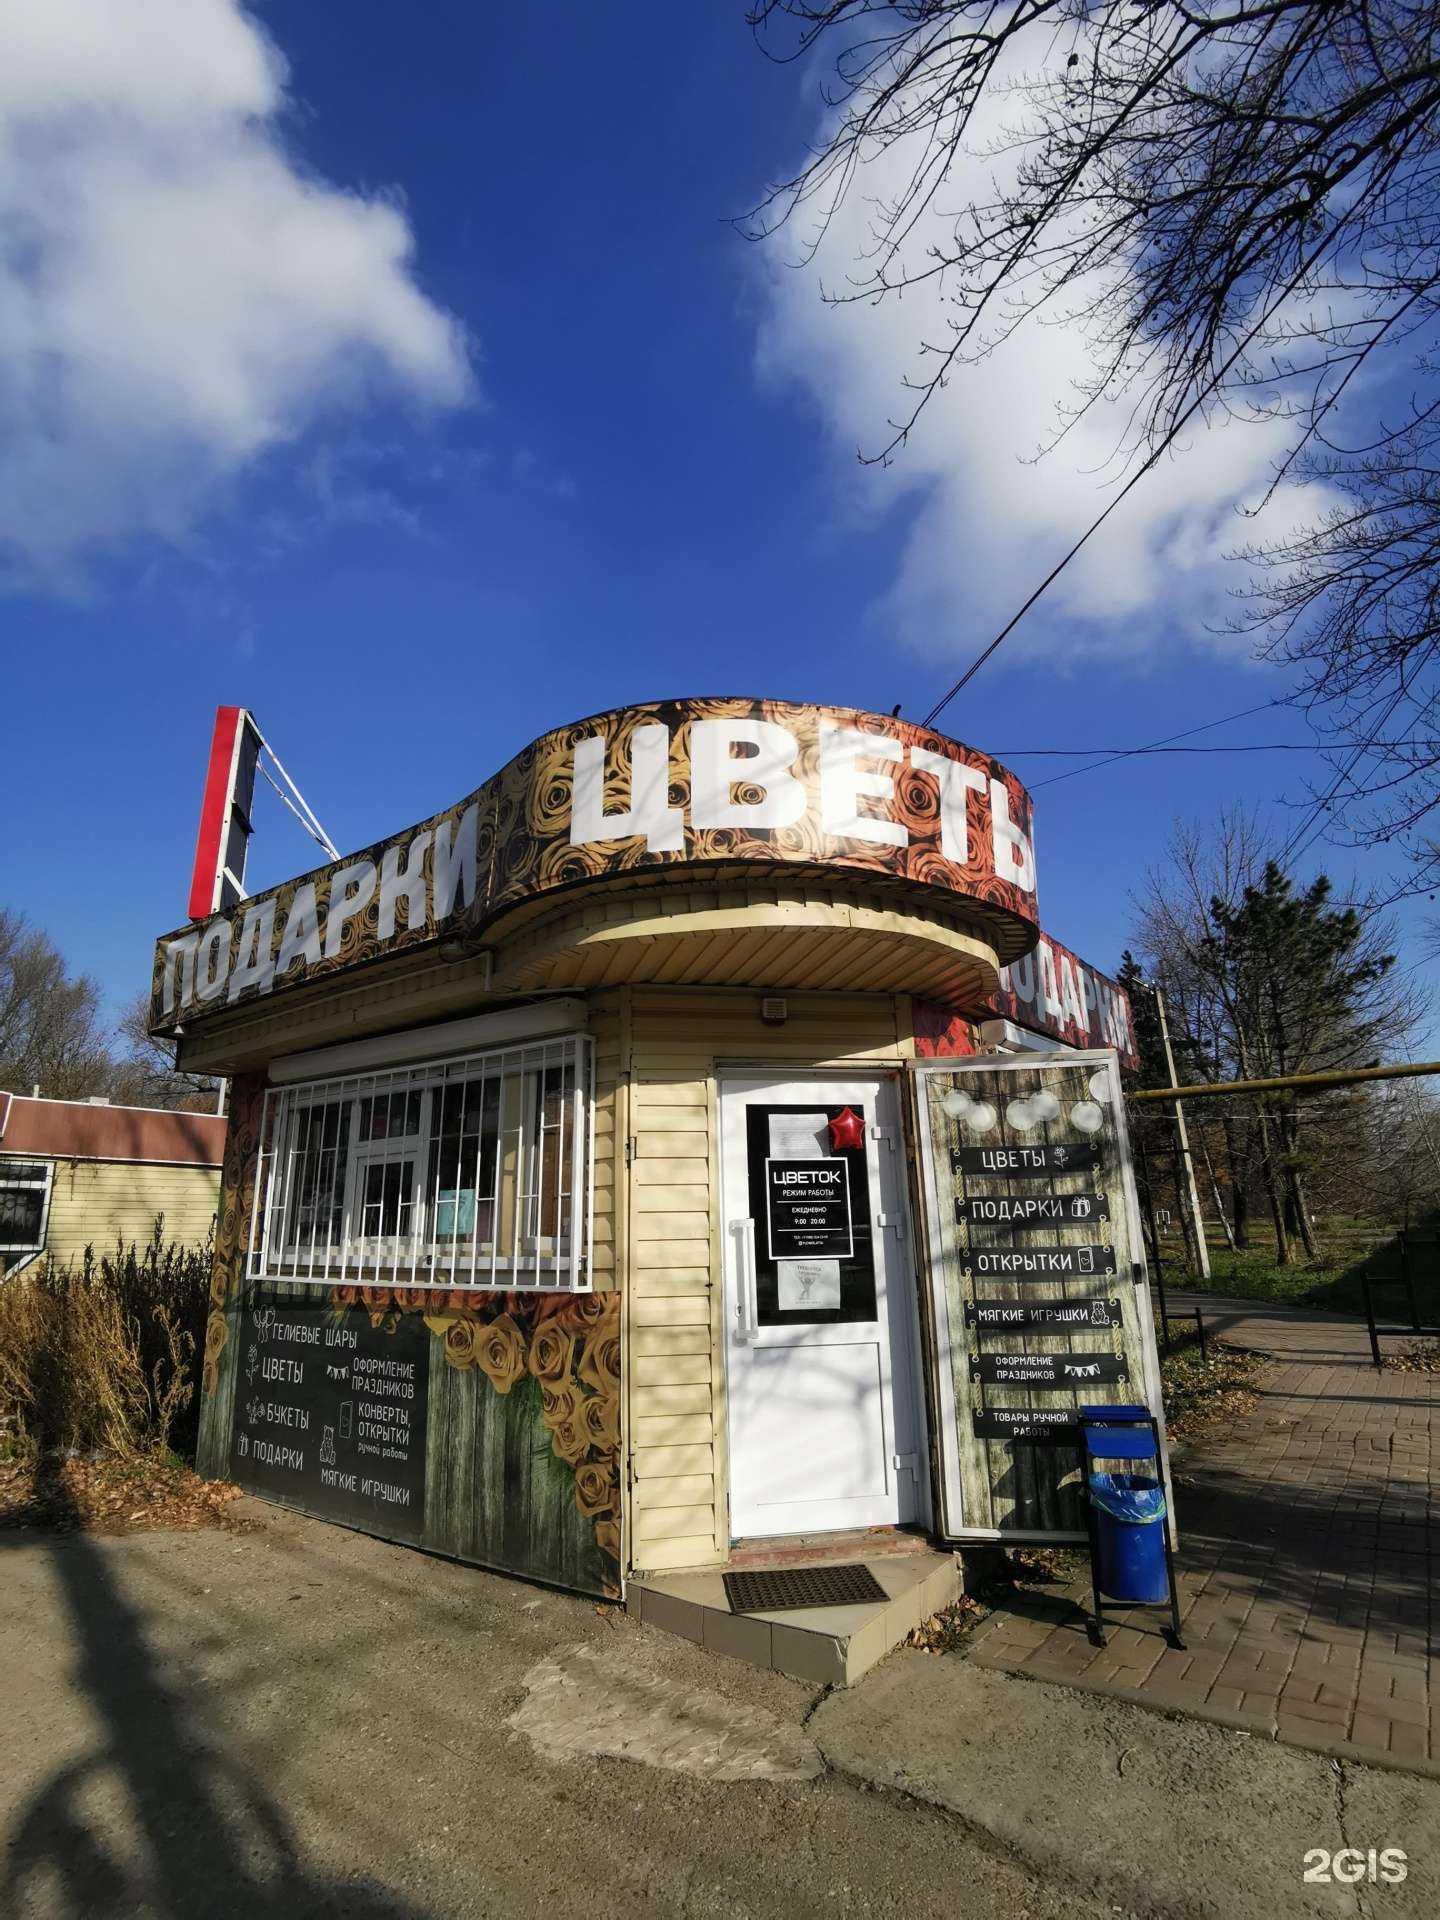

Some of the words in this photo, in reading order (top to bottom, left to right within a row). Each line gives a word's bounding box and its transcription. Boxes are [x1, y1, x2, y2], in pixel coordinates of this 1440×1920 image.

[162, 802, 480, 1015] ПОДАРКИ
[1000, 939, 1133, 1056] ОДАРКИ
[982, 1150, 1046, 1171] ЦВЕТЫ
[773, 1170, 842, 1186] ЦВЕТОК
[782, 1189, 807, 1197] РЕЖИМ
[808, 1189, 835, 1197] РАБОТЫ
[791, 1206, 828, 1214] ЕЖЕДНЕВНО
[972, 1199, 1064, 1221] ПОДАРКИ
[978, 1253, 1073, 1271] ОТКРЫТКИ
[978, 1309, 1025, 1322] МЯГКИЕ
[1030, 1308, 1090, 1322] ИГРУШКИ
[272, 1322, 321, 1345] ГЕЛИЕВЫЕ
[325, 1328, 358, 1349] ШАРЫ
[262, 1356, 304, 1384] ЦВЕТЫ
[353, 1357, 415, 1380] ОФОРМЛЕНИЕ
[995, 1356, 1054, 1366] ОФОРМЛЕНИЕ
[996, 1370, 1055, 1380] ПРАЗДНИКОВ
[352, 1376, 415, 1399] ПРАЗДНИКОВ
[267, 1403, 310, 1430] БУКЕТЫ
[358, 1402, 411, 1428] КОНВЕРТЫ,
[993, 1412, 1030, 1422] ТОВАРЫ
[1033, 1411, 1069, 1423] РУЧНОЙ
[358, 1421, 410, 1446] ОТКРЫТКИ
[1013, 1427, 1050, 1437] РАБОТЫ
[253, 1440, 304, 1471] ПОДАРКИ
[358, 1441, 380, 1455] ручной
[382, 1446, 408, 1461] работы
[321, 1468, 357, 1492] МЯГКИЕ
[361, 1477, 410, 1506] ИГРУШКИ
